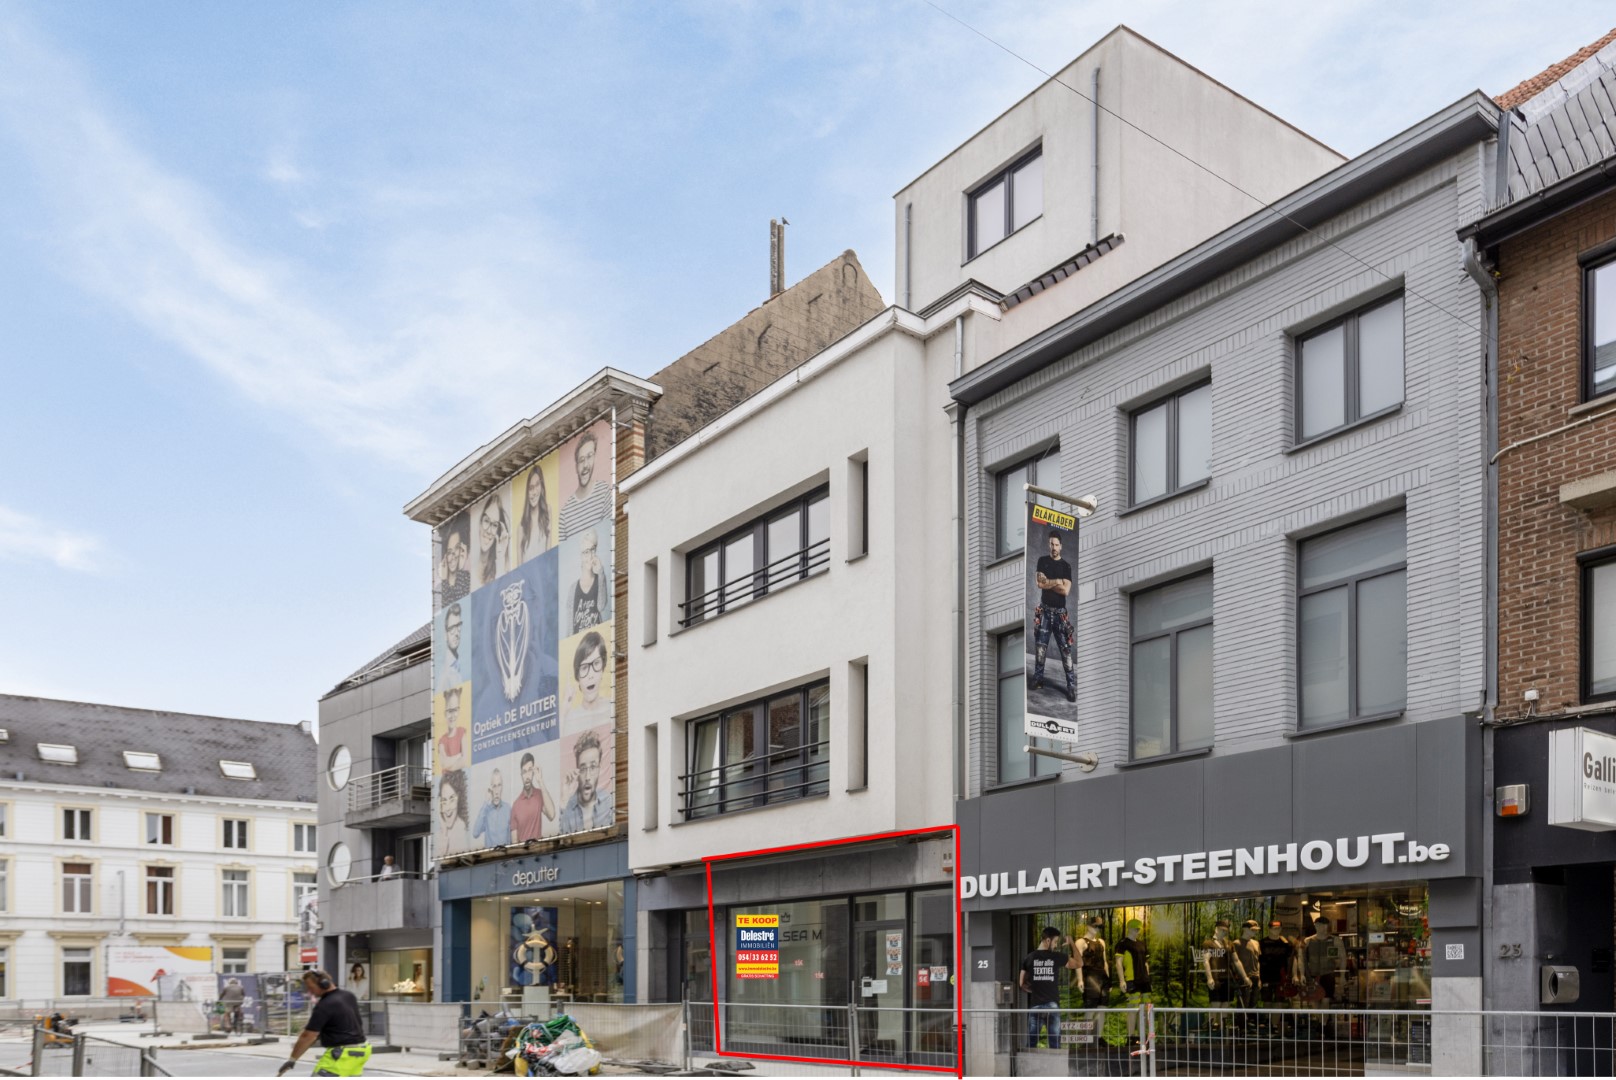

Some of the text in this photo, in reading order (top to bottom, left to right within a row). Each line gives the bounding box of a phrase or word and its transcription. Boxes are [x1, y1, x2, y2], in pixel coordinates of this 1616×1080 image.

[473, 694, 556, 736] Optiek DE PUTTER
[473, 718, 557, 752] CONTACTLENSCENTRUM
[960, 832, 1450, 899] DULLAERT-STEENHOUT.be
[512, 866, 559, 887] deputter
[741, 929, 774, 941] Delestré
[761, 953, 769, 961] 62
[770, 953, 777, 961] 52
[1500, 944, 1523, 959] 23
[978, 960, 988, 968] 25
[1033, 959, 1054, 967] Hier alle
[1033, 967, 1054, 975] TEXTIEL
